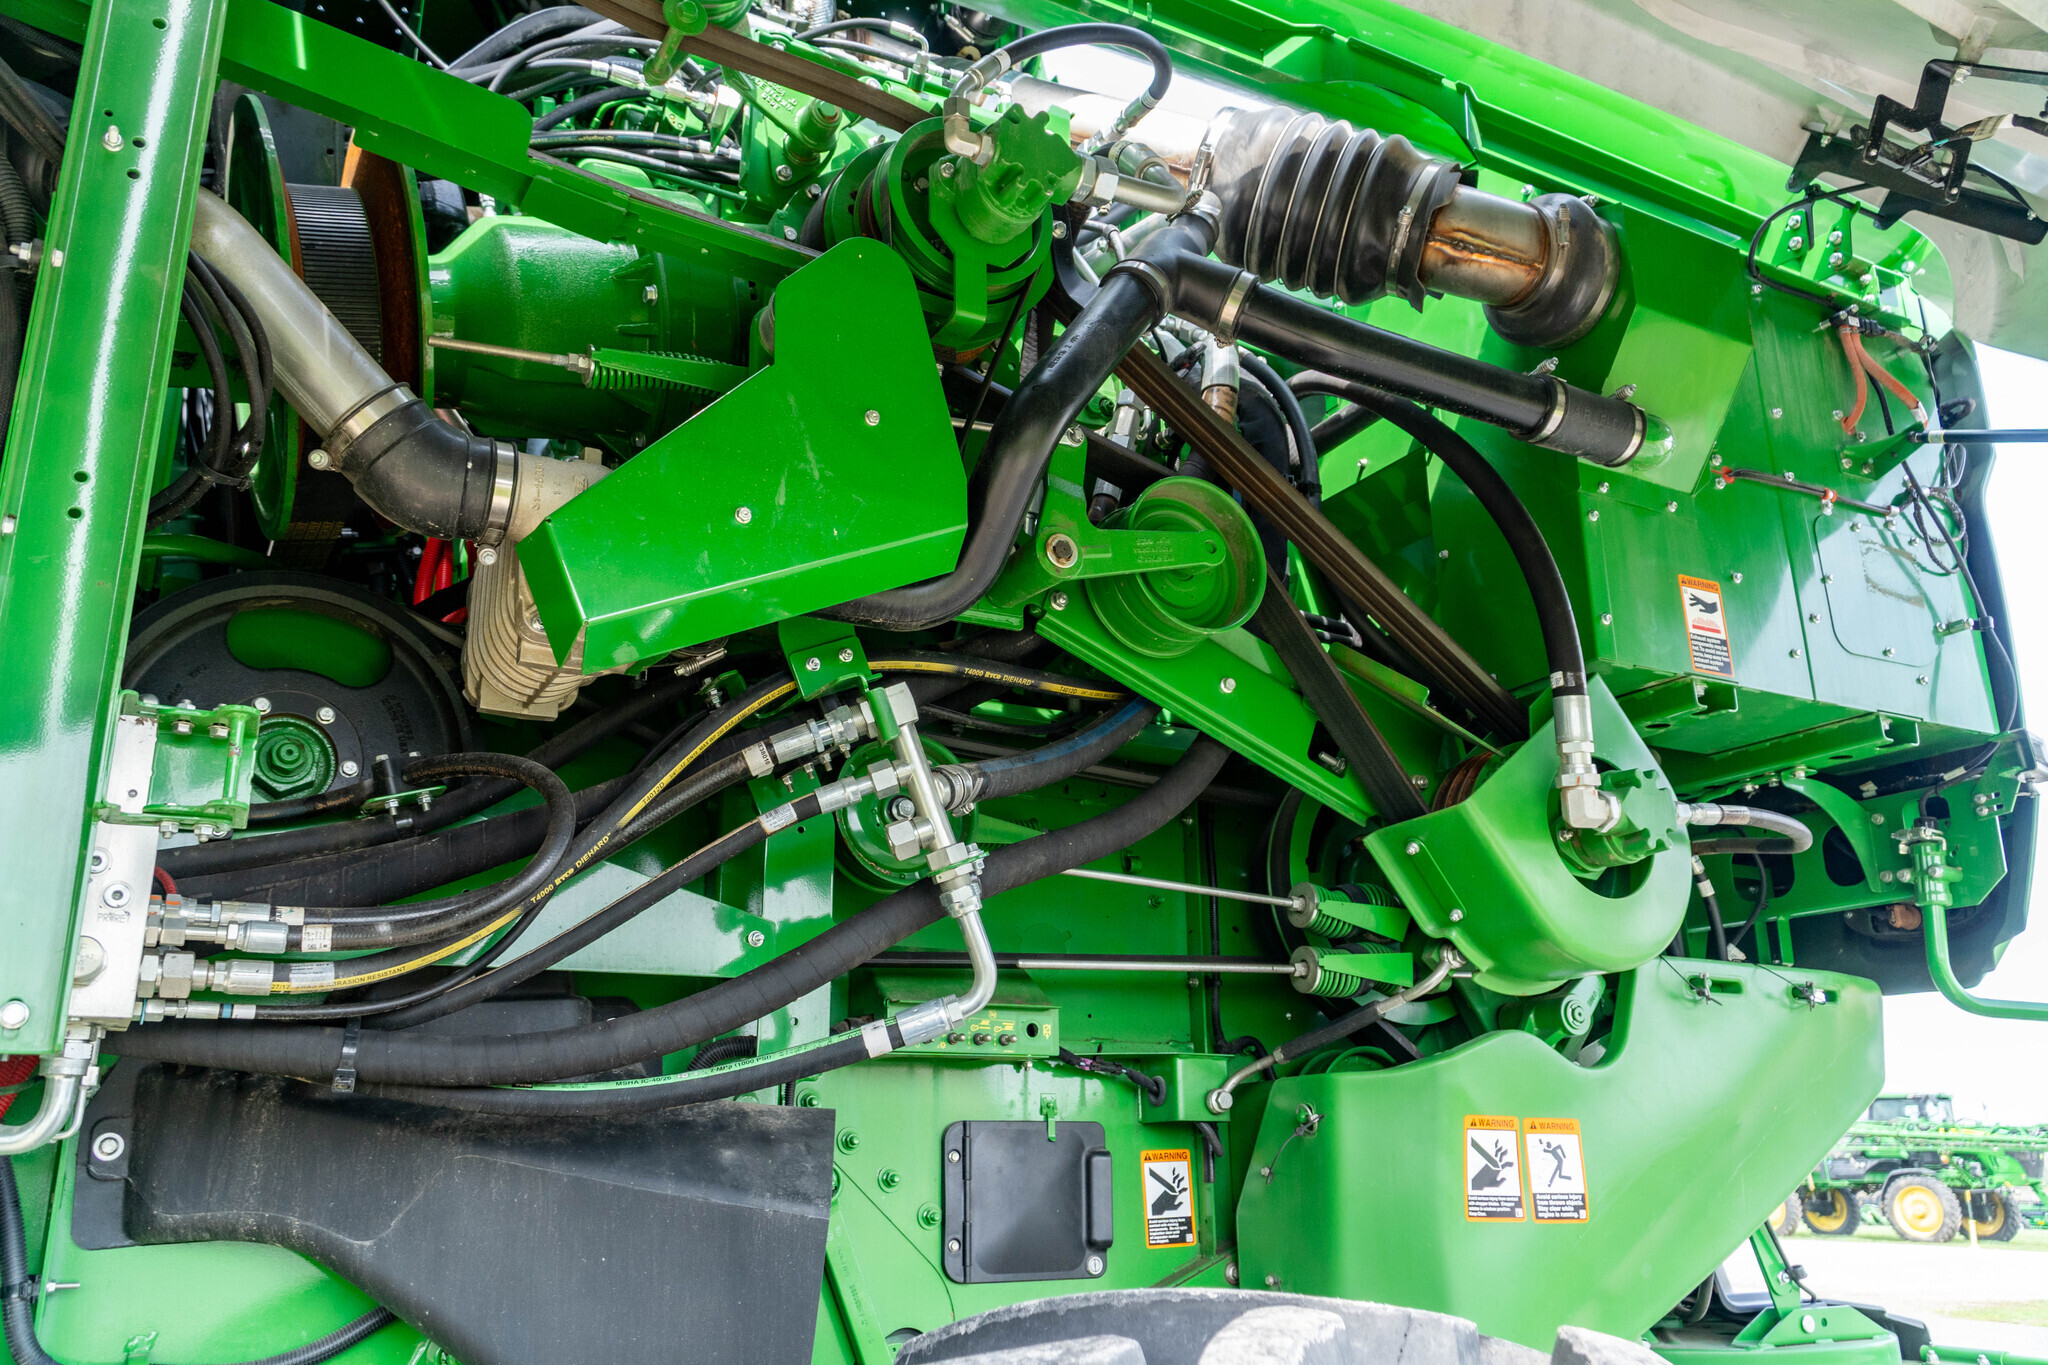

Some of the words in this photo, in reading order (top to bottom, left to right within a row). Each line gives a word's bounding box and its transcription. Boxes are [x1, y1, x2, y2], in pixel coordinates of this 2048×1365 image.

[1687, 578, 1719, 592] WARNING
[1690, 633, 1706, 641] Exhaust
[964, 668, 984, 677] T4000
[642, 781, 665, 805] T4012D
[530, 884, 554, 904] T4000
[367, 966, 406, 980] RESISTANT
[1478, 1118, 1514, 1128] WARNING
[1538, 1122, 1574, 1131] WARNING
[1152, 1152, 1188, 1160] WARNING
